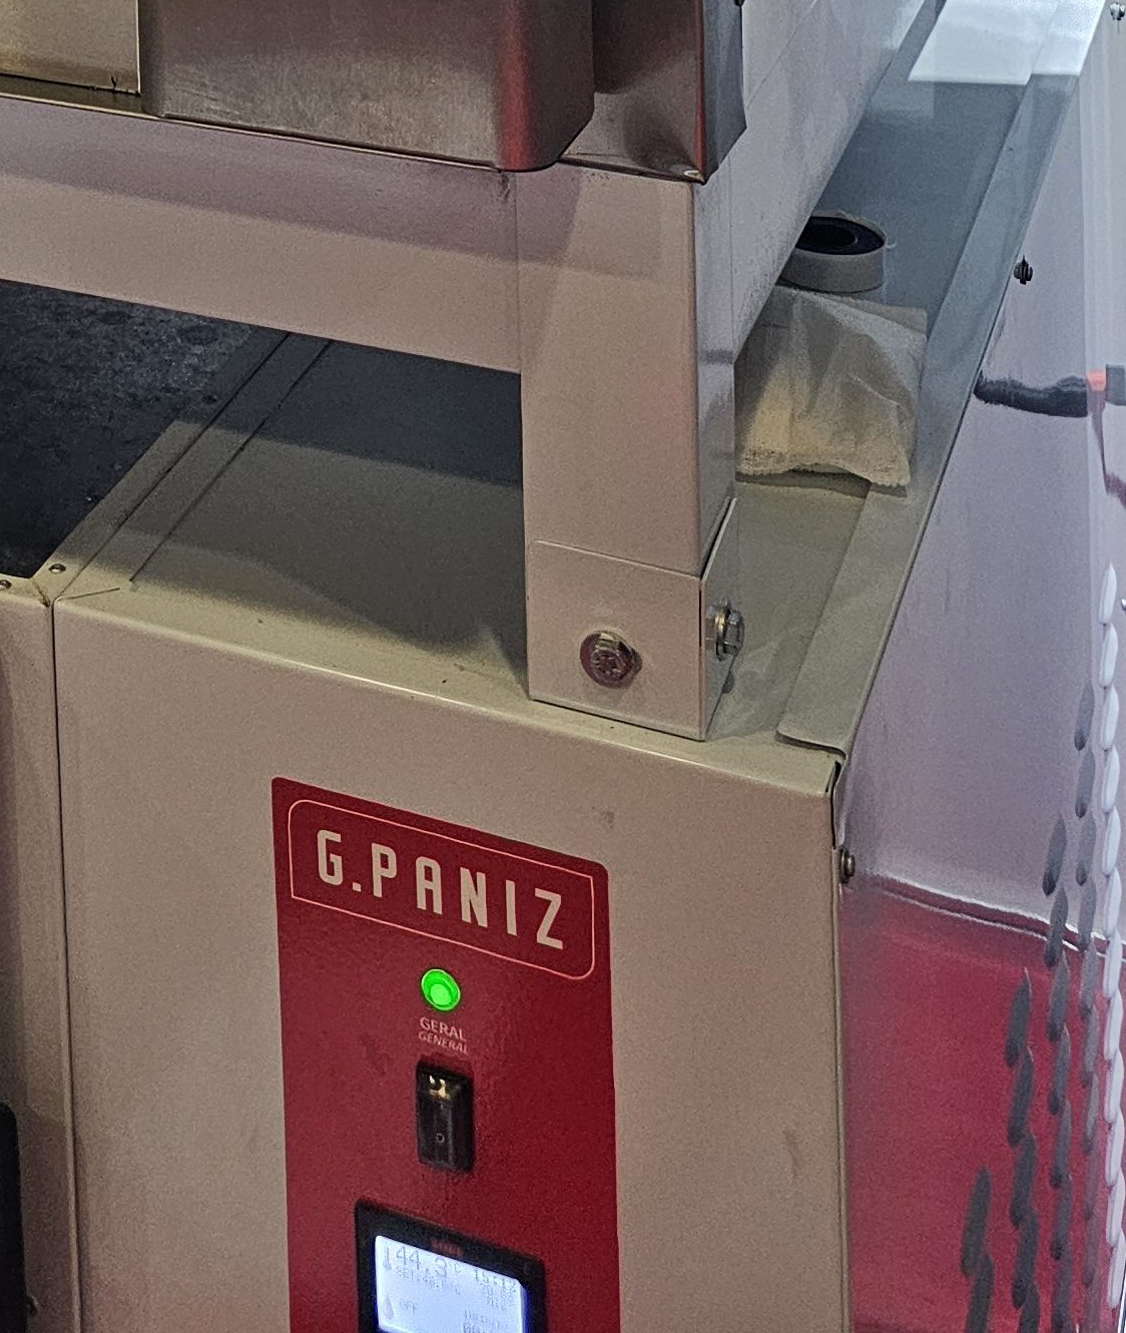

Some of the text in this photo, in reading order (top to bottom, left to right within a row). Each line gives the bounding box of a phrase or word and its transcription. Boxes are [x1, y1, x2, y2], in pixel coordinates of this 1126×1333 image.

[316, 829, 563, 949] G.PANIZ
[418, 1017, 466, 1041] GERAL
[418, 1031, 468, 1054] GENERAL
